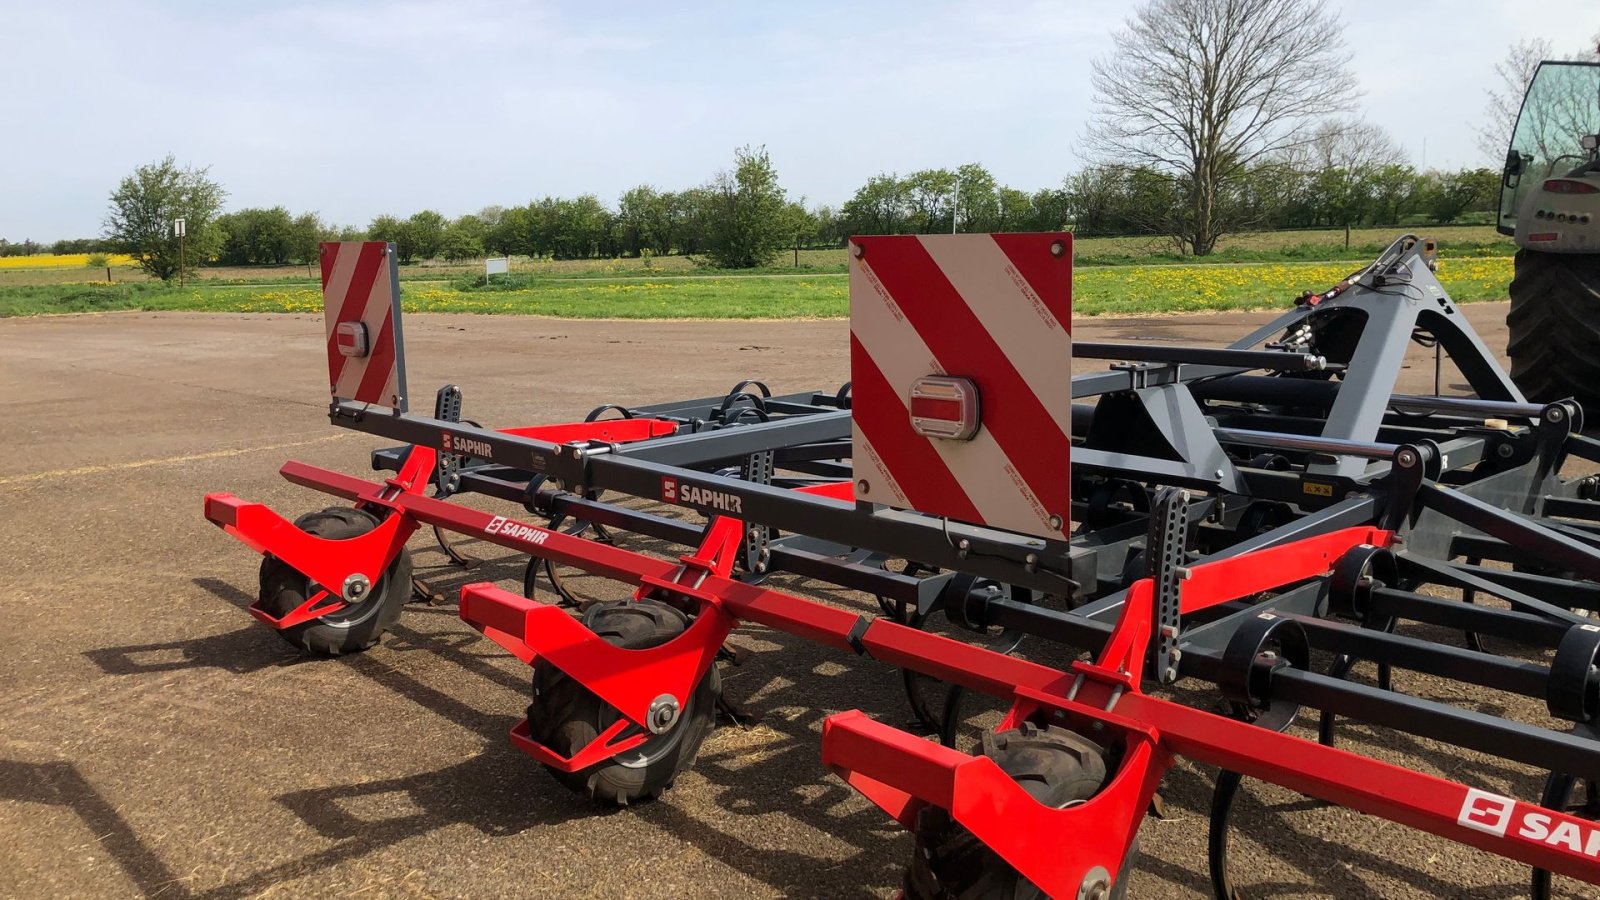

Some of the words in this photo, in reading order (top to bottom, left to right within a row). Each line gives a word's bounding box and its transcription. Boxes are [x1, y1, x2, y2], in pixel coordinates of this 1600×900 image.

[453, 436, 492, 458] SAPHIR
[680, 484, 743, 514] SAPHIR
[500, 522, 550, 545] SAPHIR
